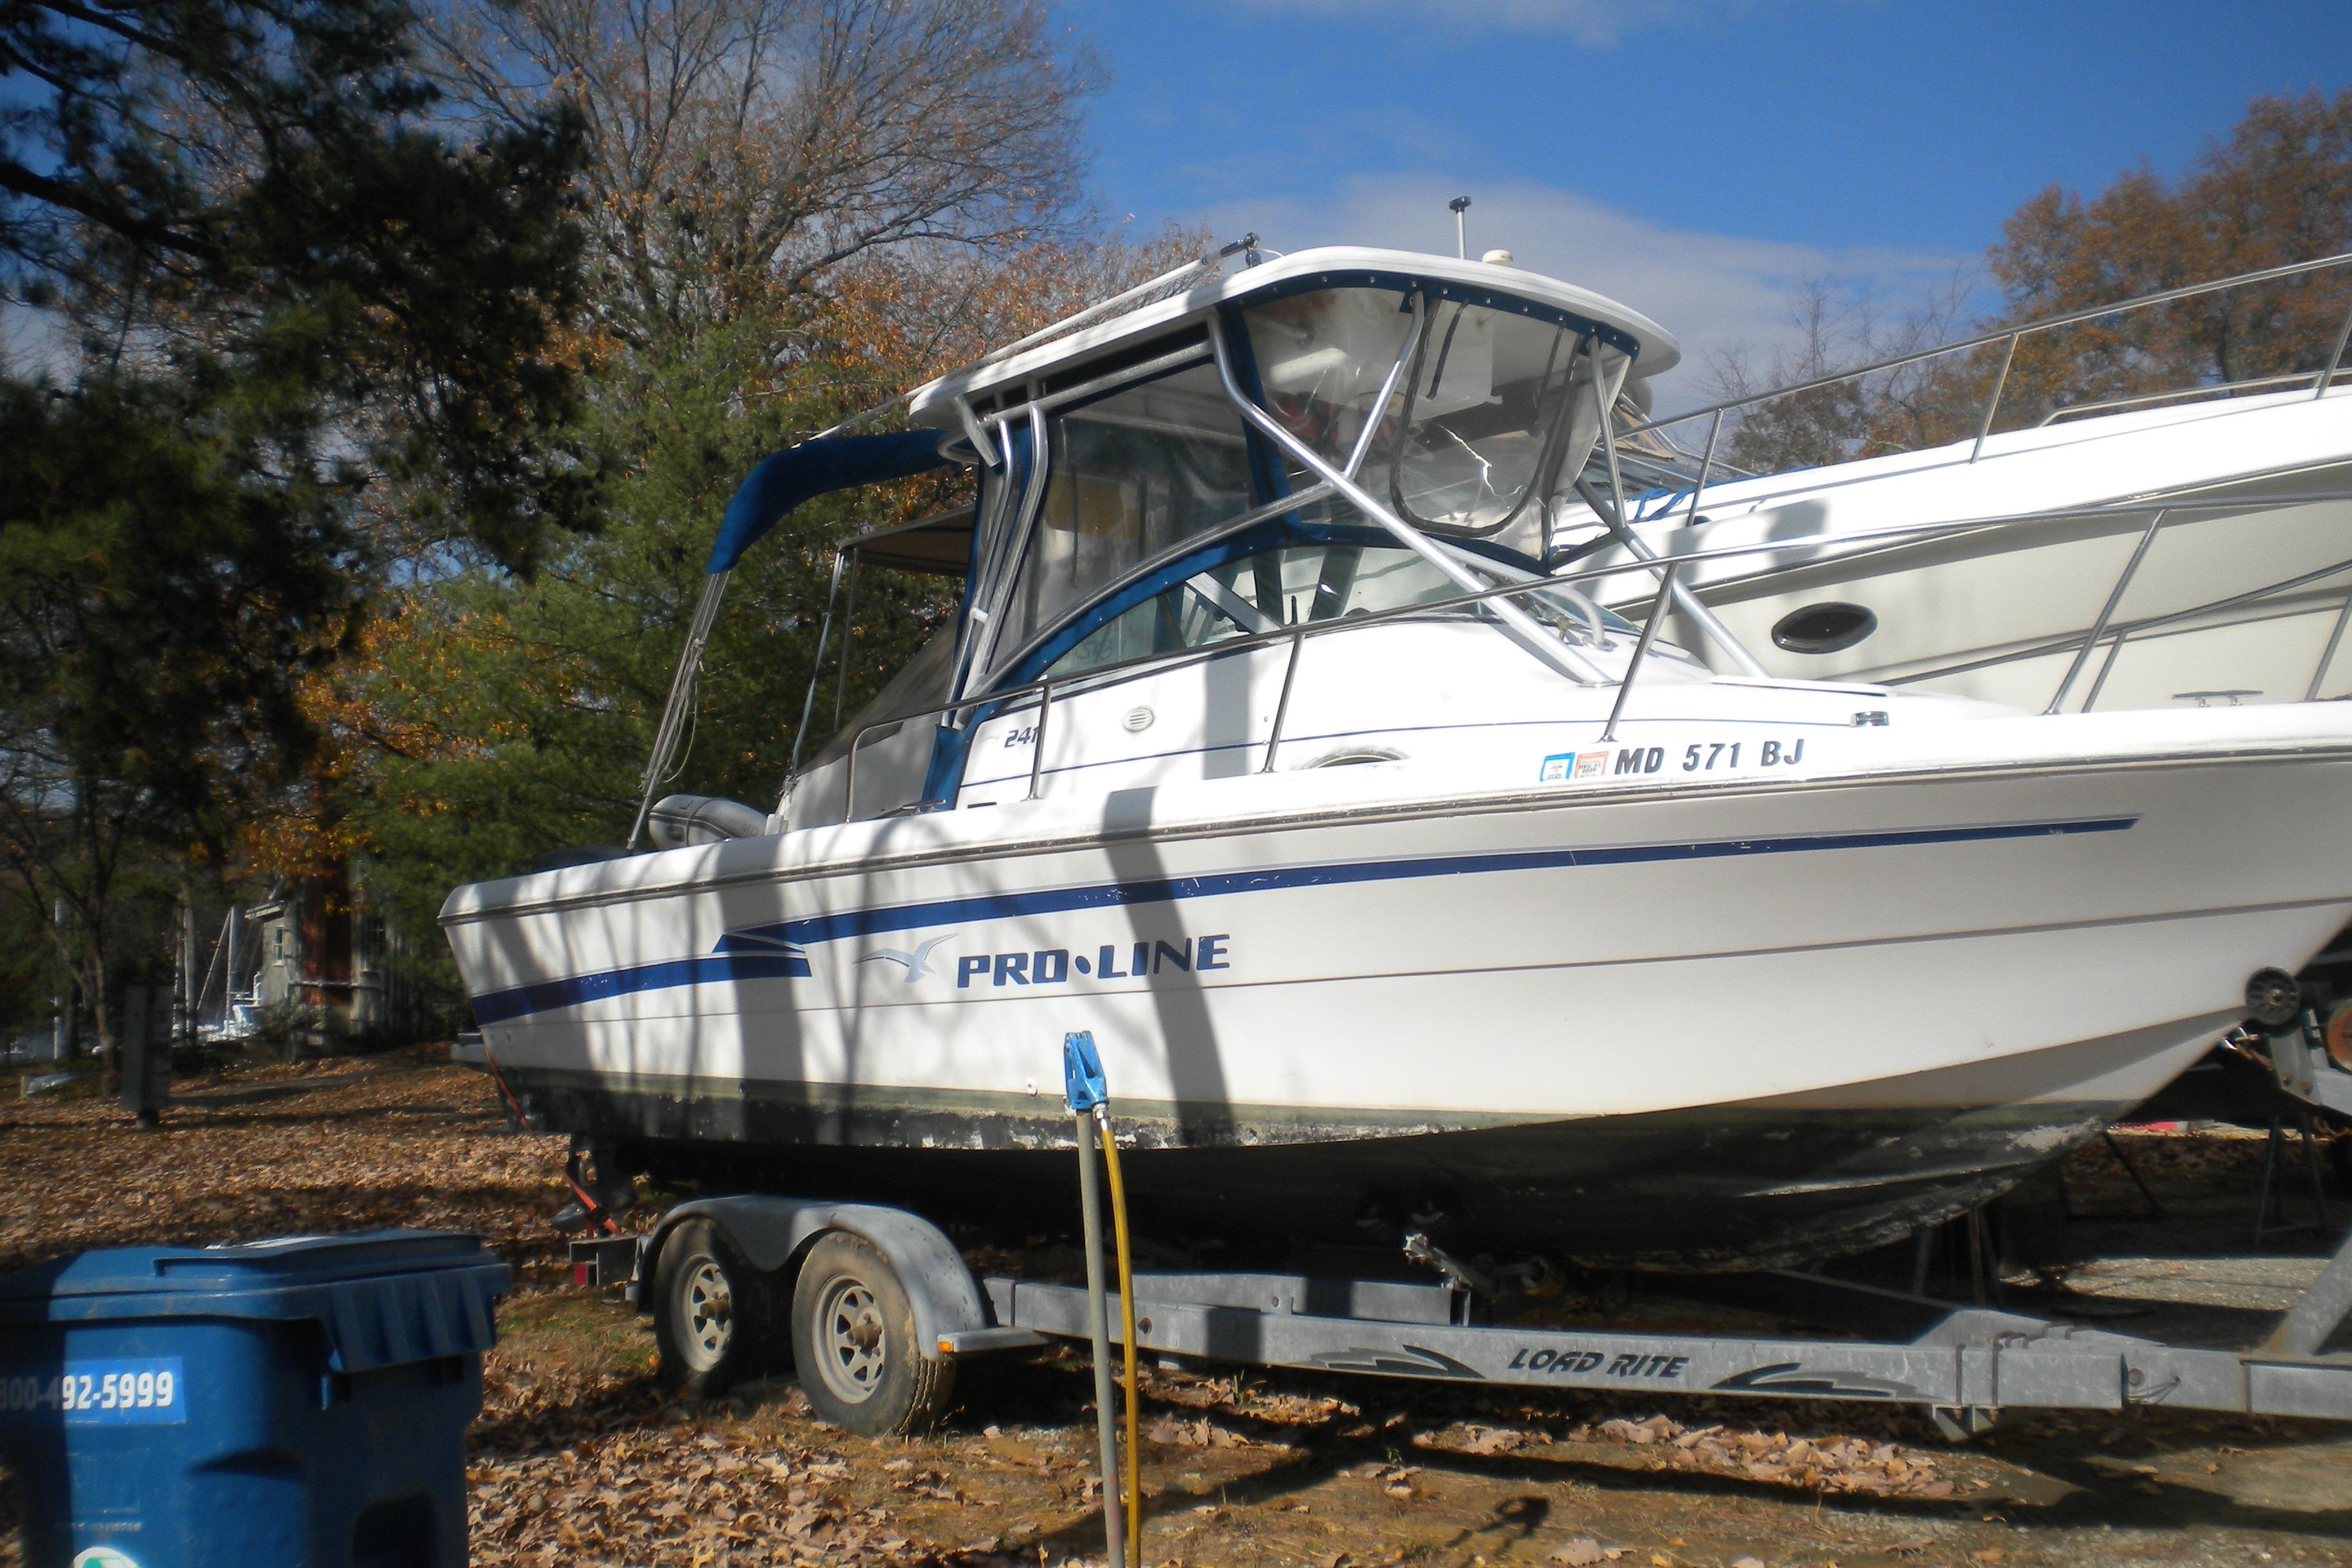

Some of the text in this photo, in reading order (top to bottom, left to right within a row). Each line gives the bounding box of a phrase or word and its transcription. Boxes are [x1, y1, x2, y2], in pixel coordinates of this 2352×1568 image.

[1614, 738, 1805, 775] MD 571 BJ
[1507, 1348, 1689, 1377] LOAD RITE
